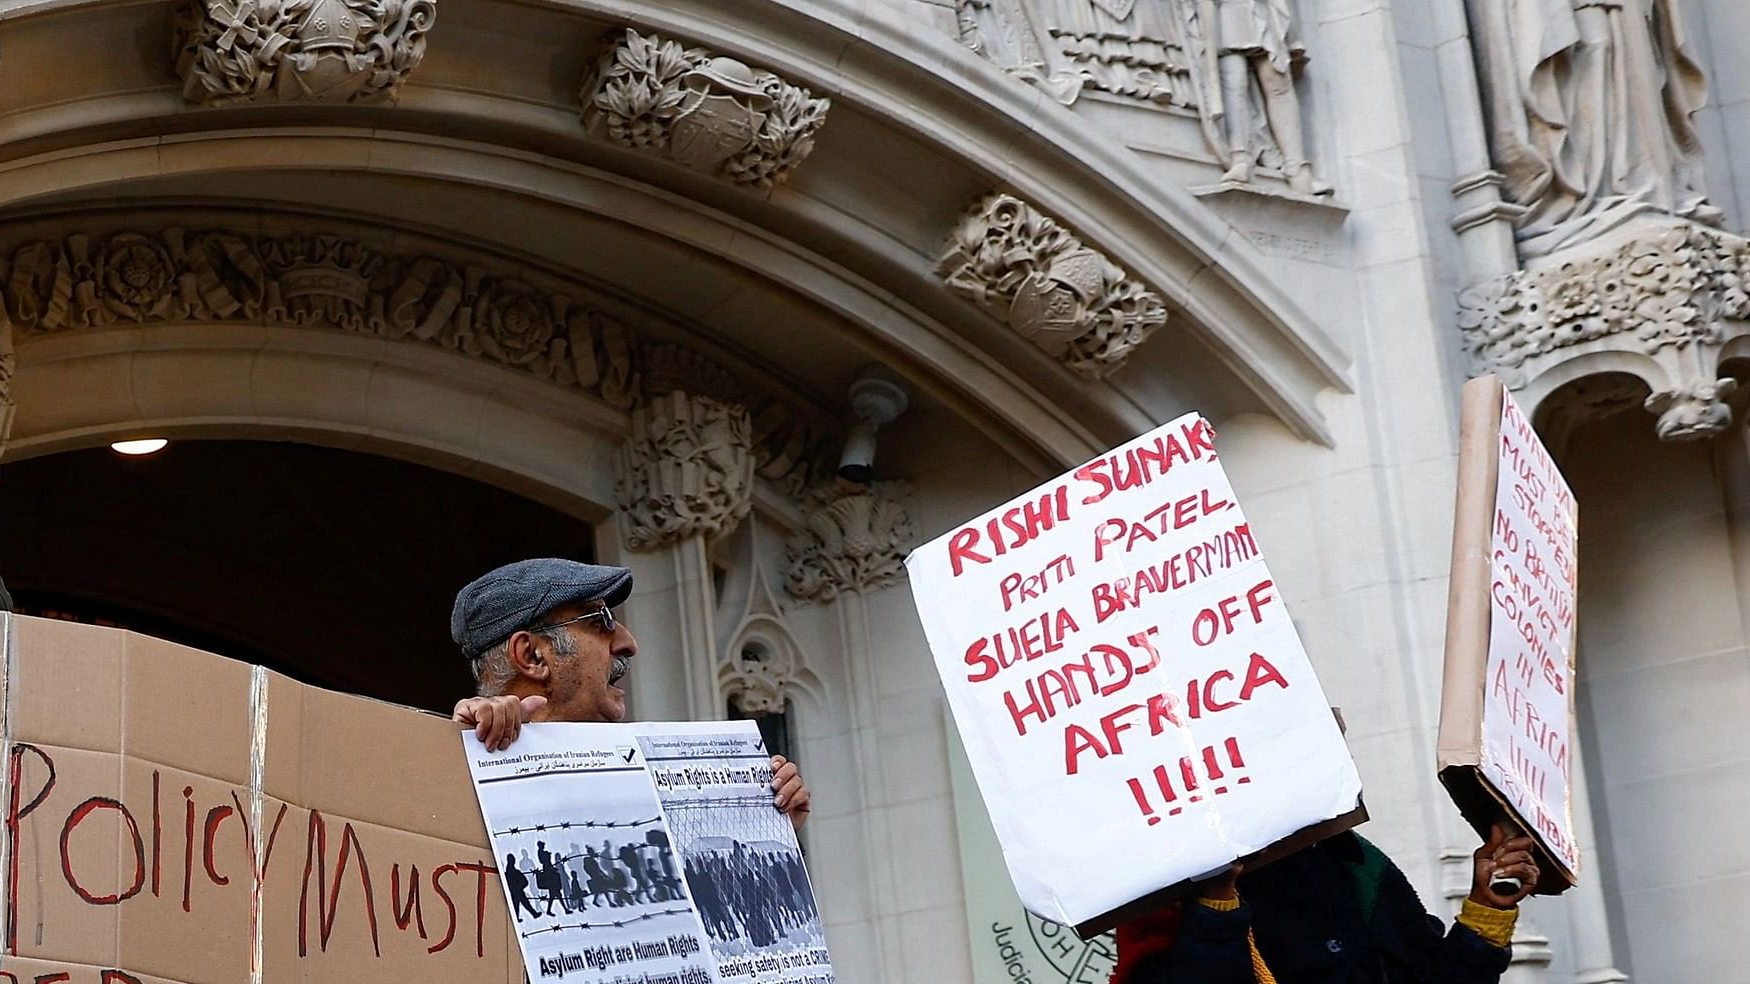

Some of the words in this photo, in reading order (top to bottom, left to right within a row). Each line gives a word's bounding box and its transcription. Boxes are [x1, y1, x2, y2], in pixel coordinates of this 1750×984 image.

[1503, 435, 1546, 502] MUST
[949, 484, 1070, 576] RISHI
[1496, 508, 1518, 553] NO
[964, 607, 1079, 682] SUELA
[1092, 522, 1259, 624] BRAVERMAN
[1004, 626, 1159, 736] HANDS
[1193, 580, 1273, 647] OFF
[1493, 581, 1564, 695] COLONIES
[1516, 652, 1534, 688] IN
[1064, 652, 1289, 775] AFRICA
[1494, 659, 1566, 779] AFRICA
[478, 755, 522, 768] International
[523, 751, 562, 763] Organisation
[655, 769, 686, 790] Asylum
[684, 767, 711, 789] Rights
[710, 767, 719, 784] is
[719, 771, 726, 784] a
[724, 767, 750, 784] Human
[539, 951, 585, 978] Asylum
[583, 947, 616, 970] Right
[615, 947, 634, 962] are
[632, 940, 669, 960] Human
[668, 934, 700, 958] Rights
[719, 960, 756, 978] seeking
[754, 955, 781, 974] safety
[780, 953, 791, 969] is
[790, 952, 805, 968] not
[804, 954, 811, 966] a
